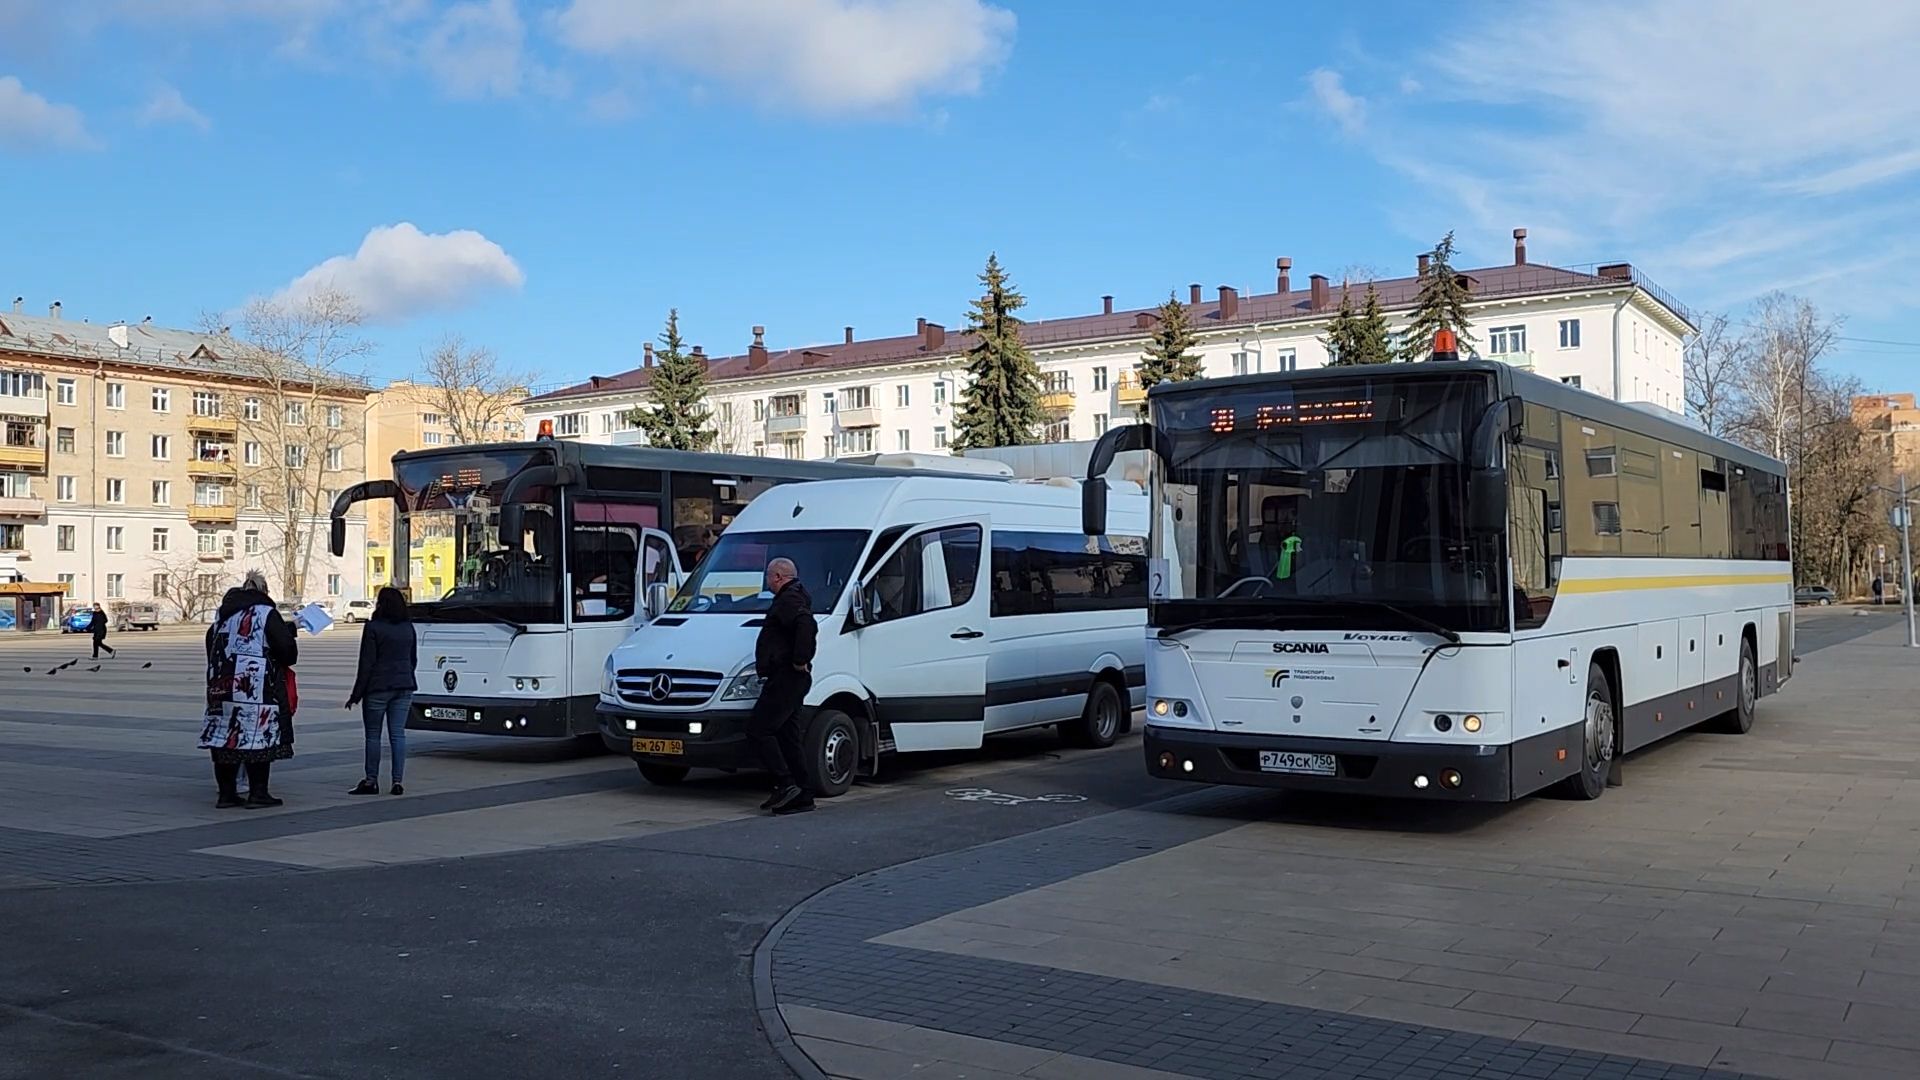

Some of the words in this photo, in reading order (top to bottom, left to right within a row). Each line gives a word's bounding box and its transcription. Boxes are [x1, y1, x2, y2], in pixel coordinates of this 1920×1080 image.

[1153, 572, 1163, 596] 2
[1273, 643, 1329, 654] SCANIA
[649, 740, 666, 752] 267
[1313, 754, 1333, 766] 750
